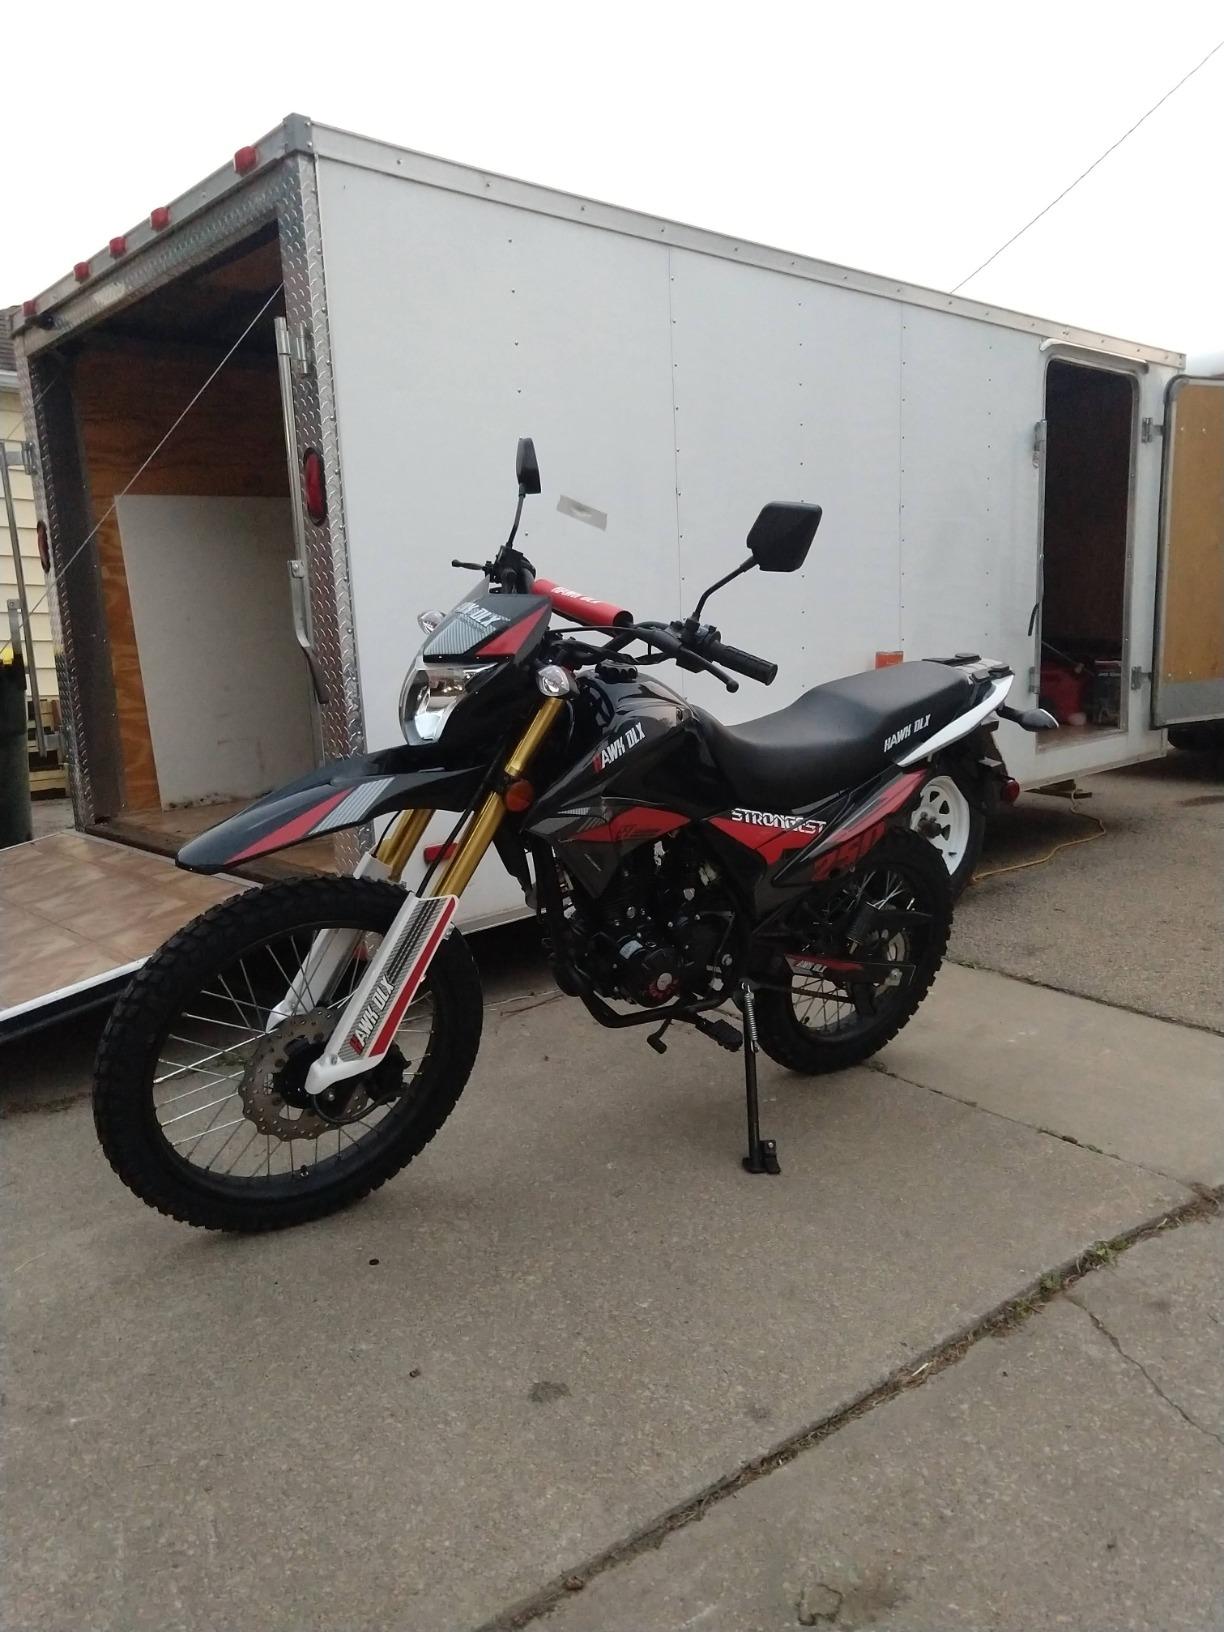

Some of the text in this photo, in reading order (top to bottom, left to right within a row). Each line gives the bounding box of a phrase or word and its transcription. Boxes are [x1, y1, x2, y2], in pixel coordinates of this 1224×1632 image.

[469, 607, 501, 628] DLX
[625, 721, 646, 749] DLX
[884, 713, 932, 753] HAWK DLX
[371, 975, 395, 1011] DLX
